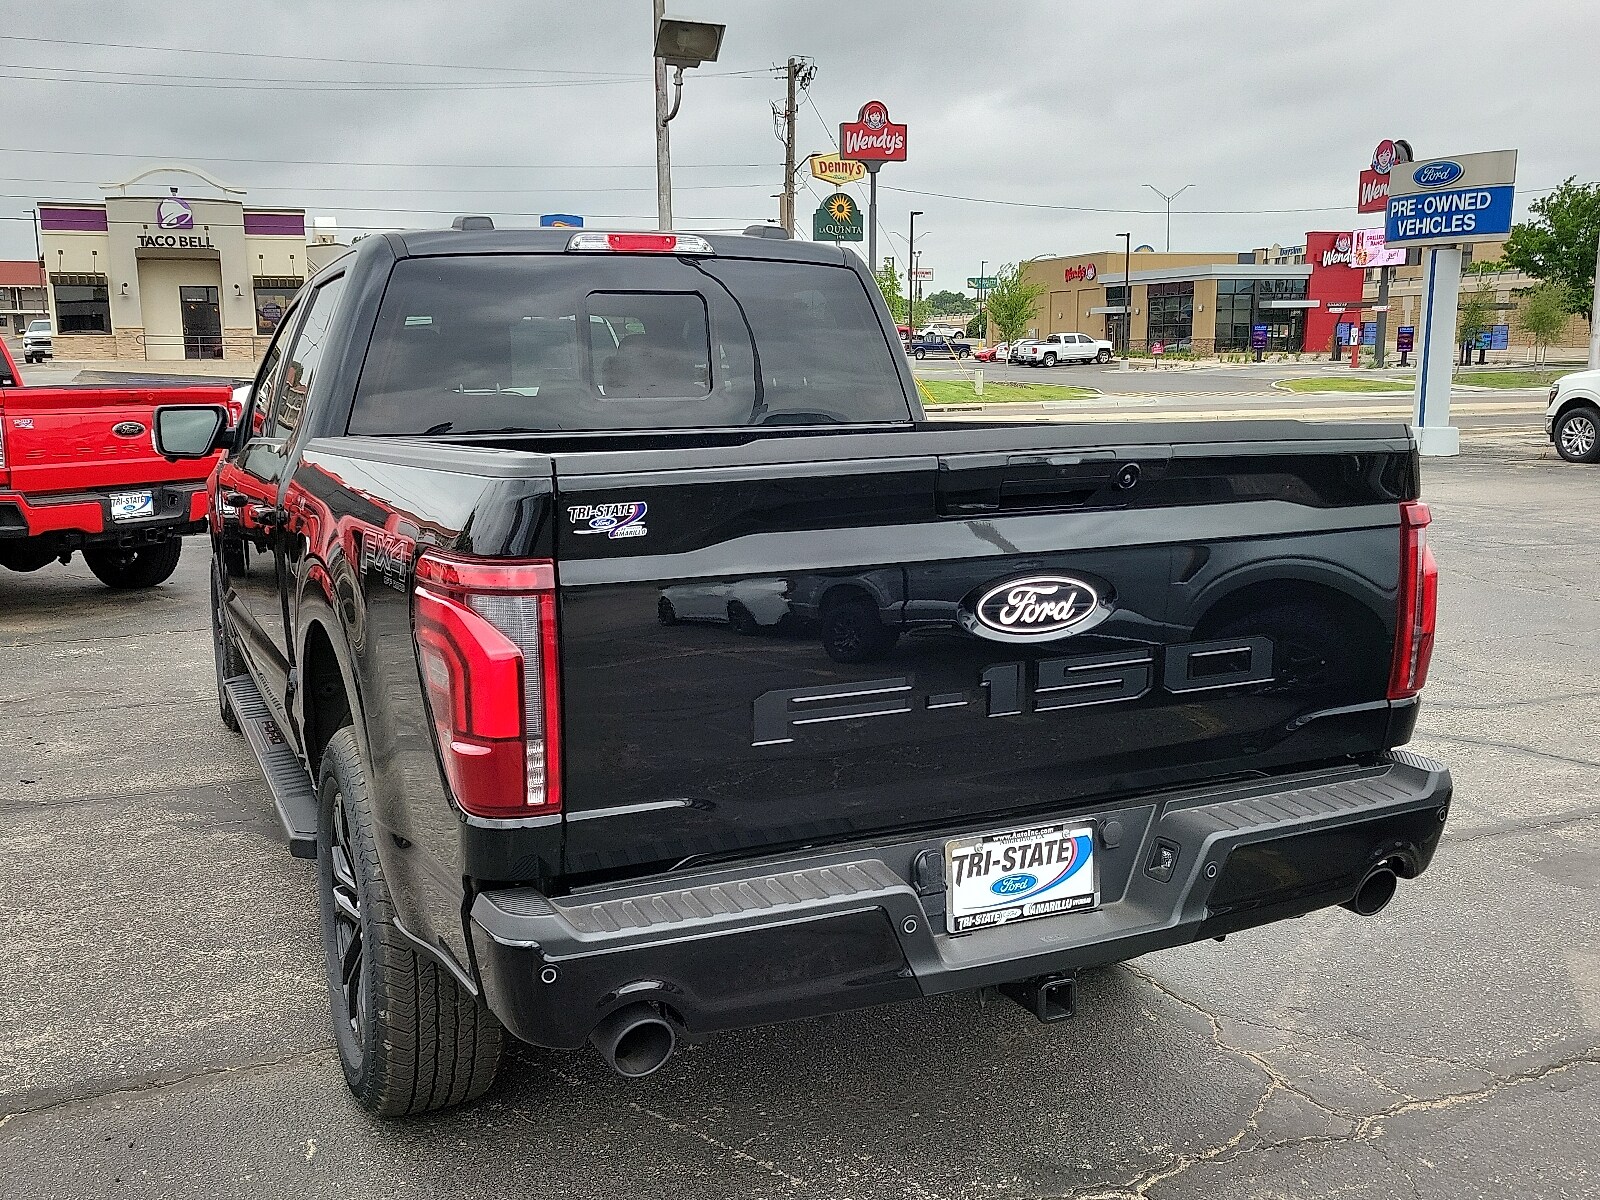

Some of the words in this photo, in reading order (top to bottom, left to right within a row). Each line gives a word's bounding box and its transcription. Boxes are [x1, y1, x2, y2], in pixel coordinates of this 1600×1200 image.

[846, 127, 905, 155] Wendy's
[818, 160, 862, 176] Denny's
[1420, 166, 1452, 183] Ford
[1390, 191, 1492, 219] PRE-OWNED
[825, 224, 863, 236] QUINTA
[1397, 213, 1476, 237] VEHICLES
[137, 235, 176, 248] TACO
[178, 235, 215, 248] BELL
[567, 503, 636, 523] TRI-STATE
[615, 529, 647, 537] AMARILLO
[360, 528, 407, 582] FX4
[999, 585, 1076, 626] Ford
[751, 635, 1275, 746] F-150
[993, 827, 1055, 842] www.AutoInc.com
[952, 837, 1070, 888] TRI-STATE
[1000, 875, 1029, 893] Ford
